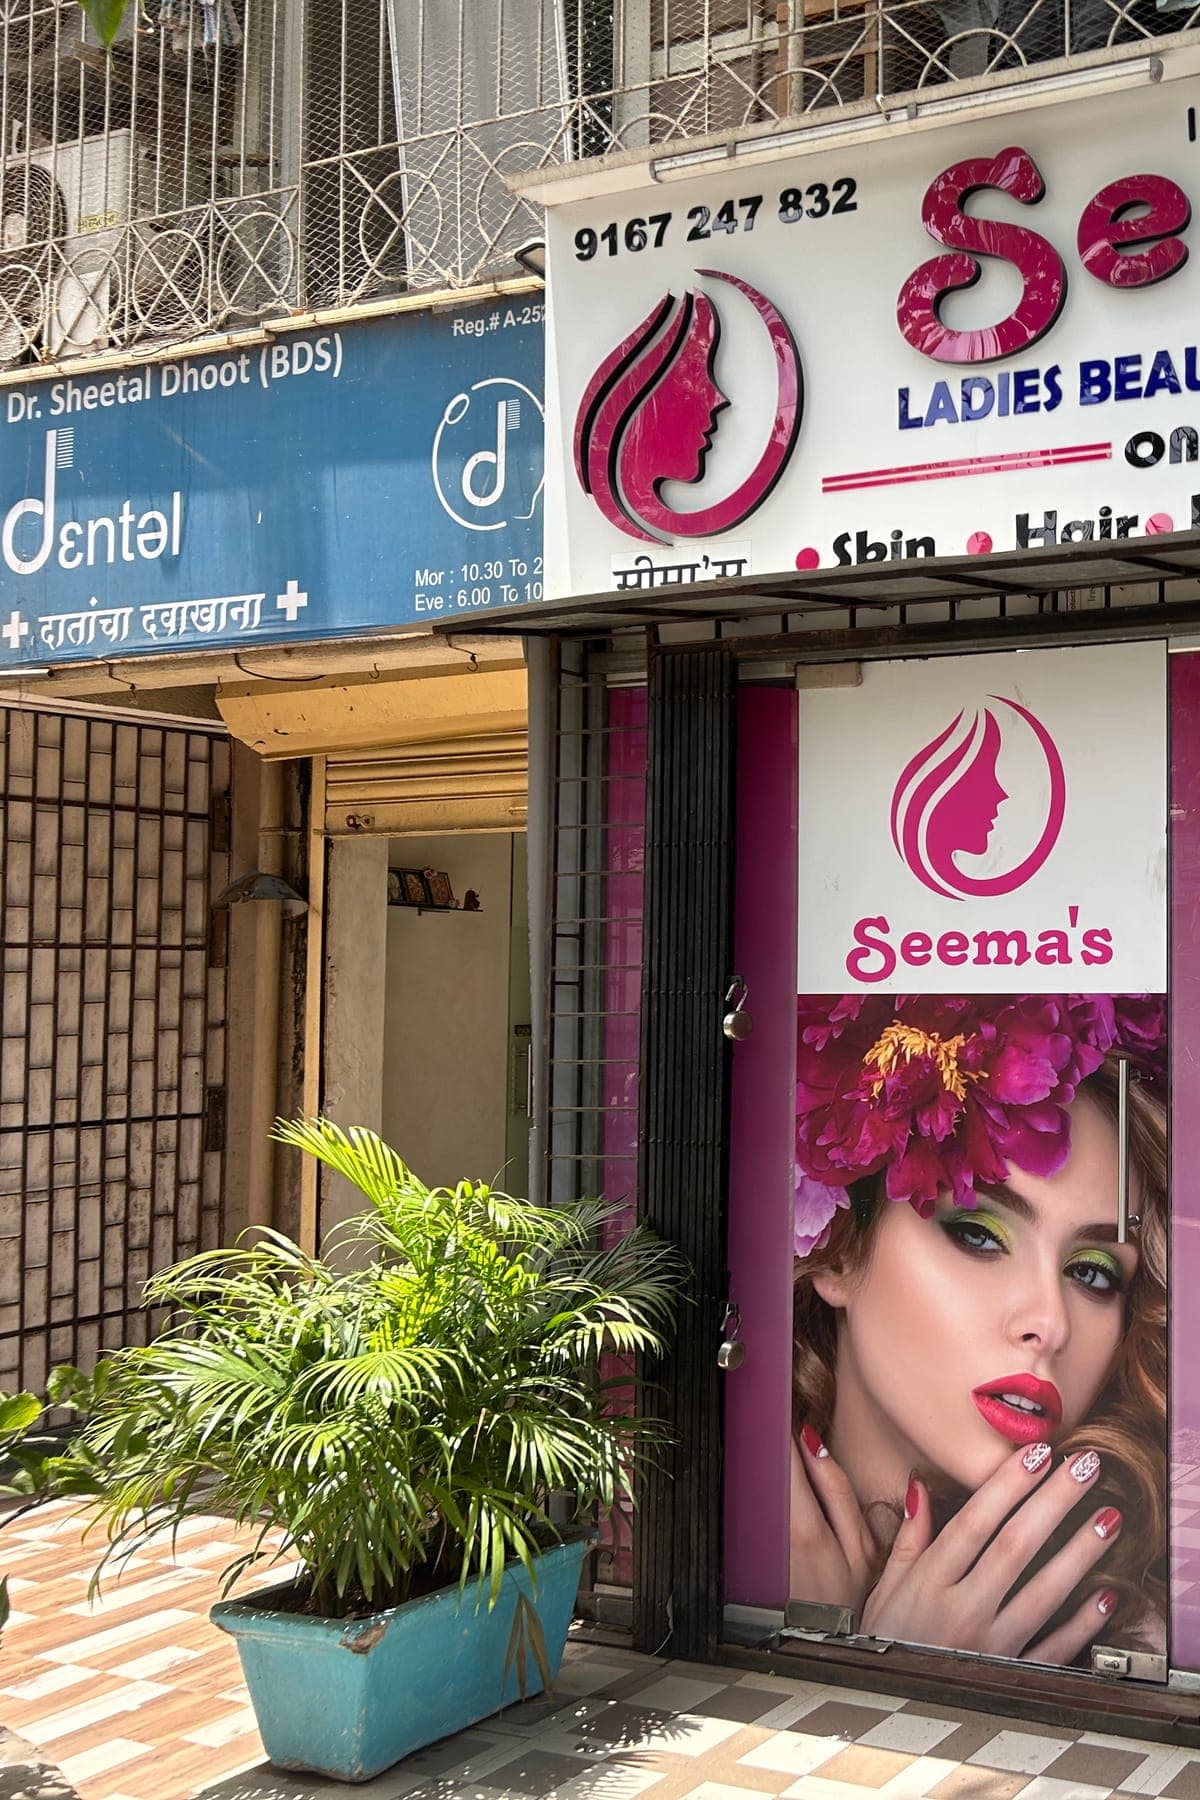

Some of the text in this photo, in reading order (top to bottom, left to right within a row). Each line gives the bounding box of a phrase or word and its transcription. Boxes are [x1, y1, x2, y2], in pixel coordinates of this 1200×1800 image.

[574, 177, 859, 262] 9167 247 832
[452, 311, 500, 337] Reg.#
[7, 333, 344, 424] Dr. Sheetal Dhoot (BDS)
[897, 364, 1063, 431] LADIES
[1015, 505, 1139, 551] Hair
[415, 568, 445, 587] Mor
[460, 561, 503, 582] 10.30
[508, 558, 527, 577] To
[140, 593, 266, 641] दवाखाना
[415, 594, 444, 612] Eve
[457, 587, 491, 607] 6.00
[500, 584, 519, 603] To
[846, 905, 1113, 983] Seema's
